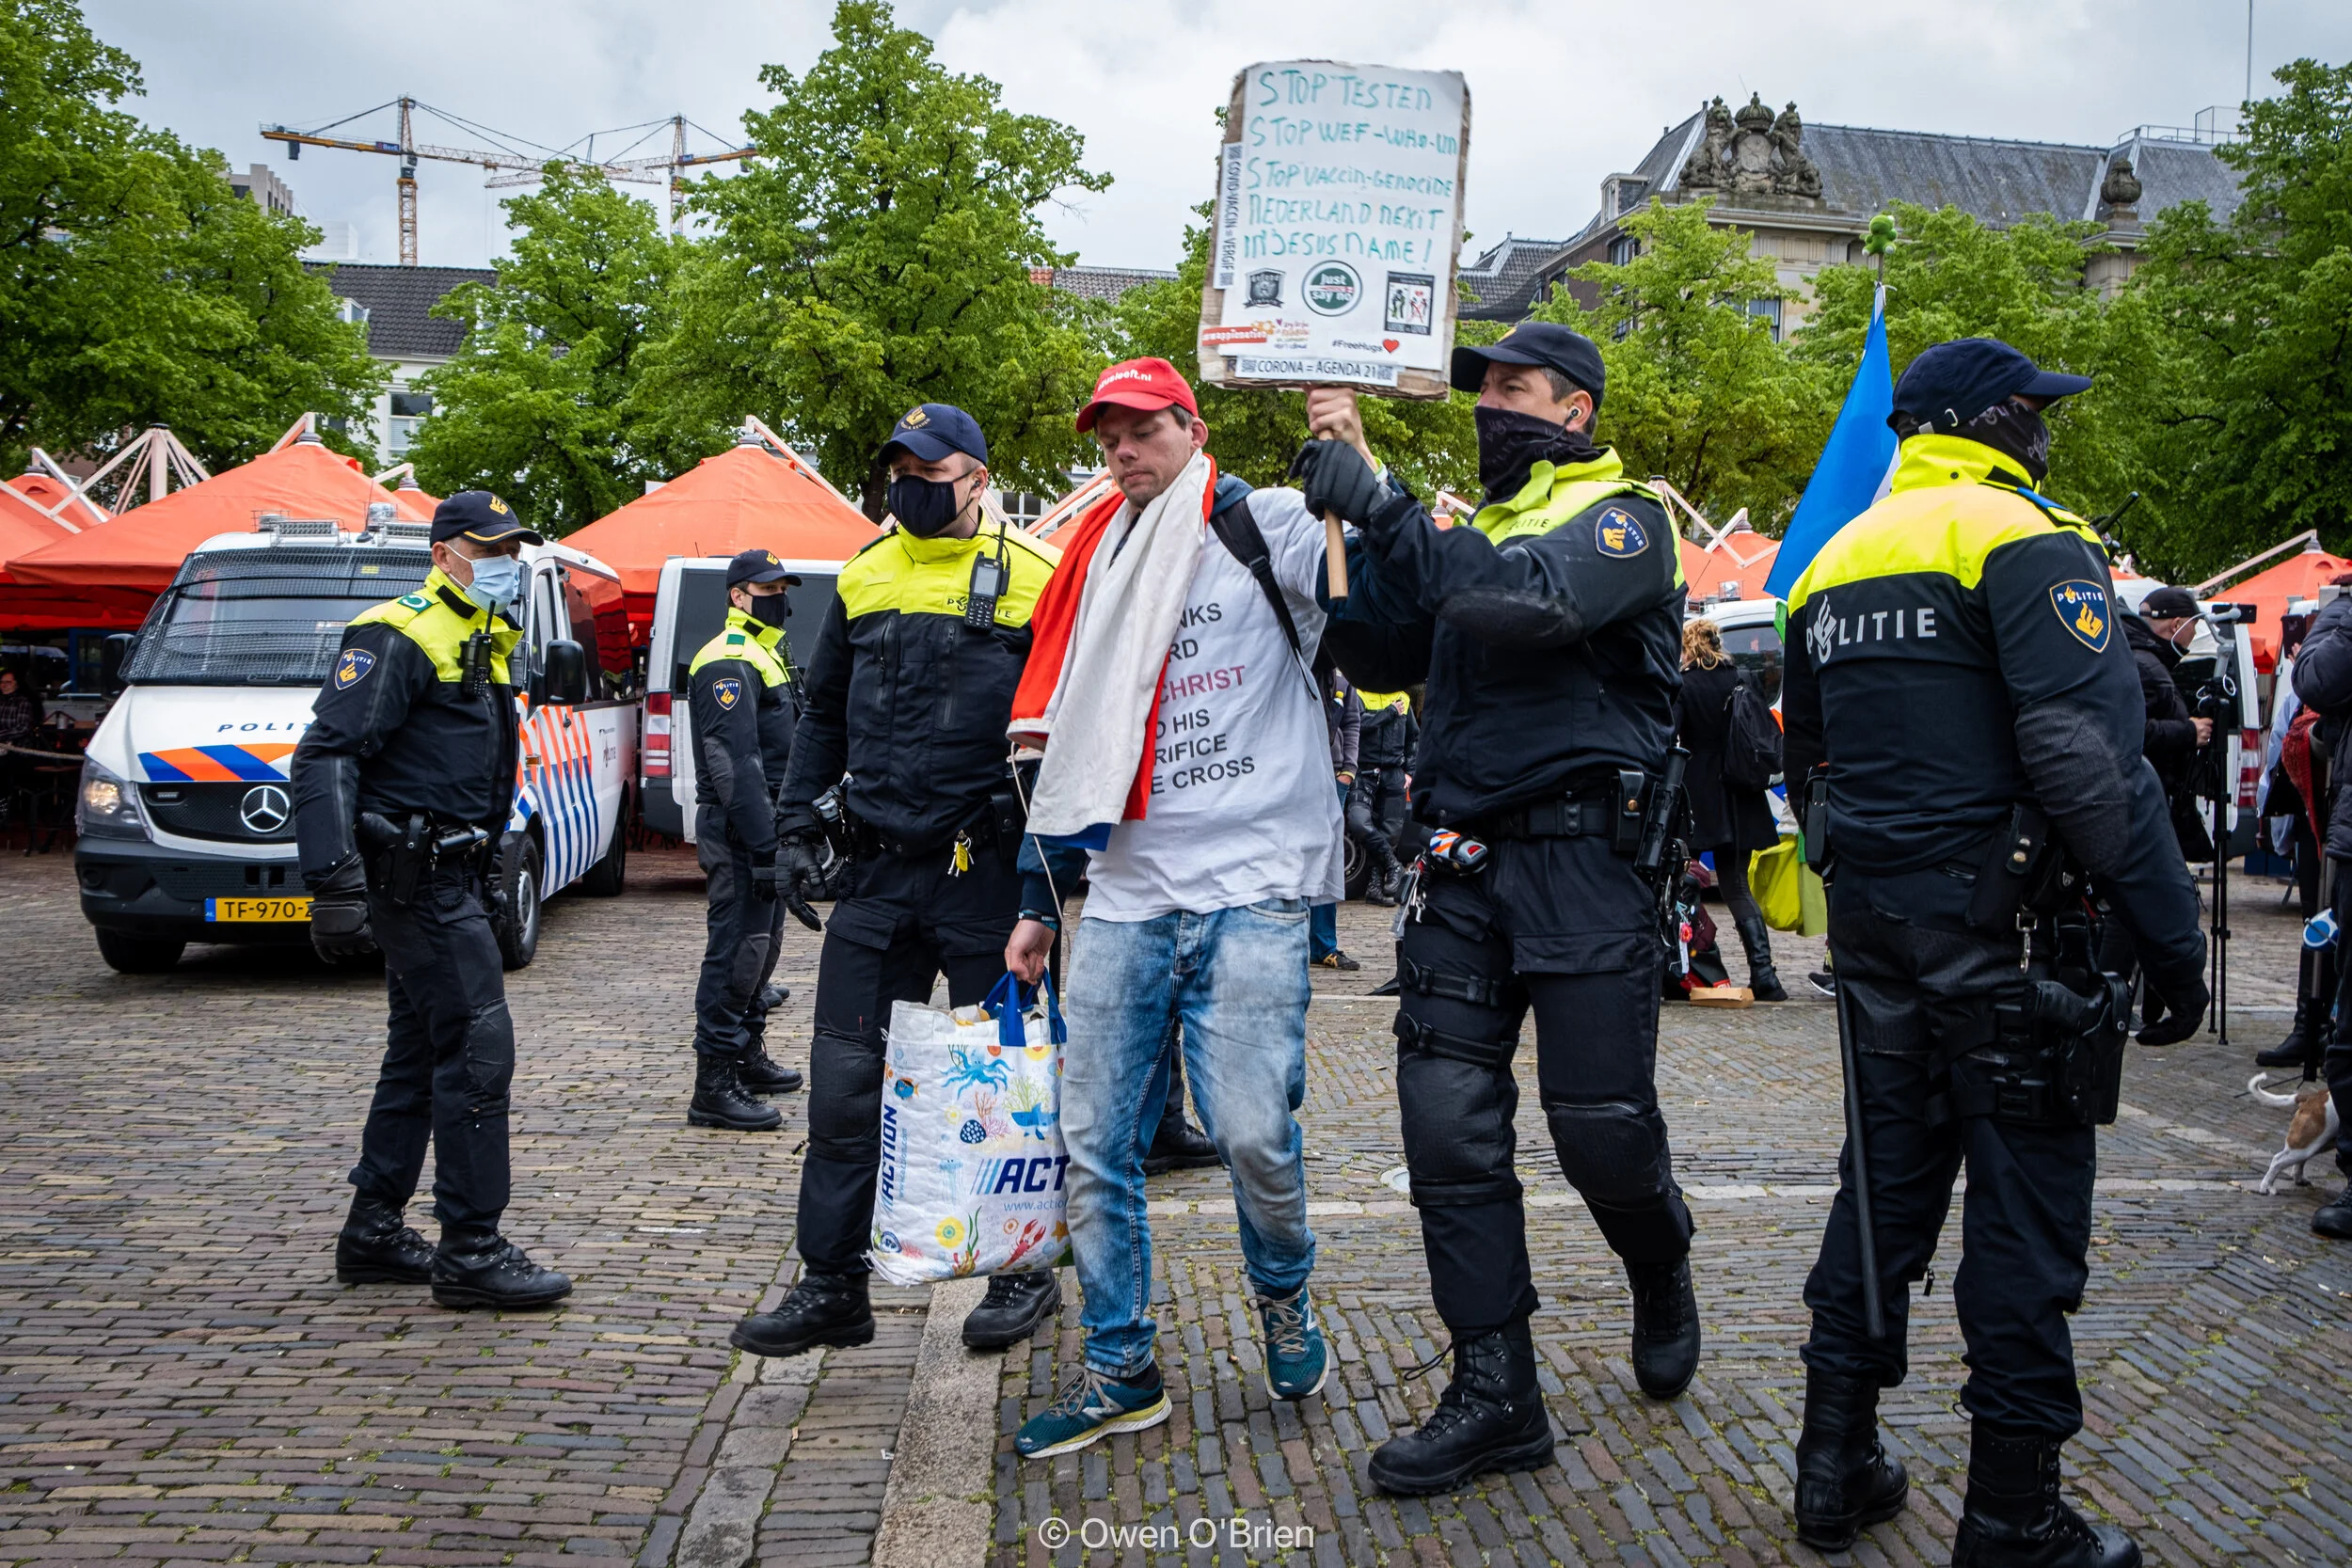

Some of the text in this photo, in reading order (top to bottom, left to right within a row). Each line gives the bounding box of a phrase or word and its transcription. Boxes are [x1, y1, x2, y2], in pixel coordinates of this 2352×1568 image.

[1259, 70, 1327, 107] STOP
[1248, 116, 1313, 147] STOP
[1247, 156, 1299, 190] STOP
[1221, 237, 1236, 270] VERGIF
[1332, 340, 1383, 353] #FreeHugs
[1258, 360, 1304, 373] CORONA
[1317, 361, 1361, 376] AGENDA
[1363, 365, 1376, 377] 21
[2057, 591, 2105, 604] POLITIE
[1806, 606, 1937, 663] POLITIE
[1173, 709, 1210, 734] HIS
[1172, 756, 1255, 788] CROSS
[882, 1103, 897, 1201] ACTION
